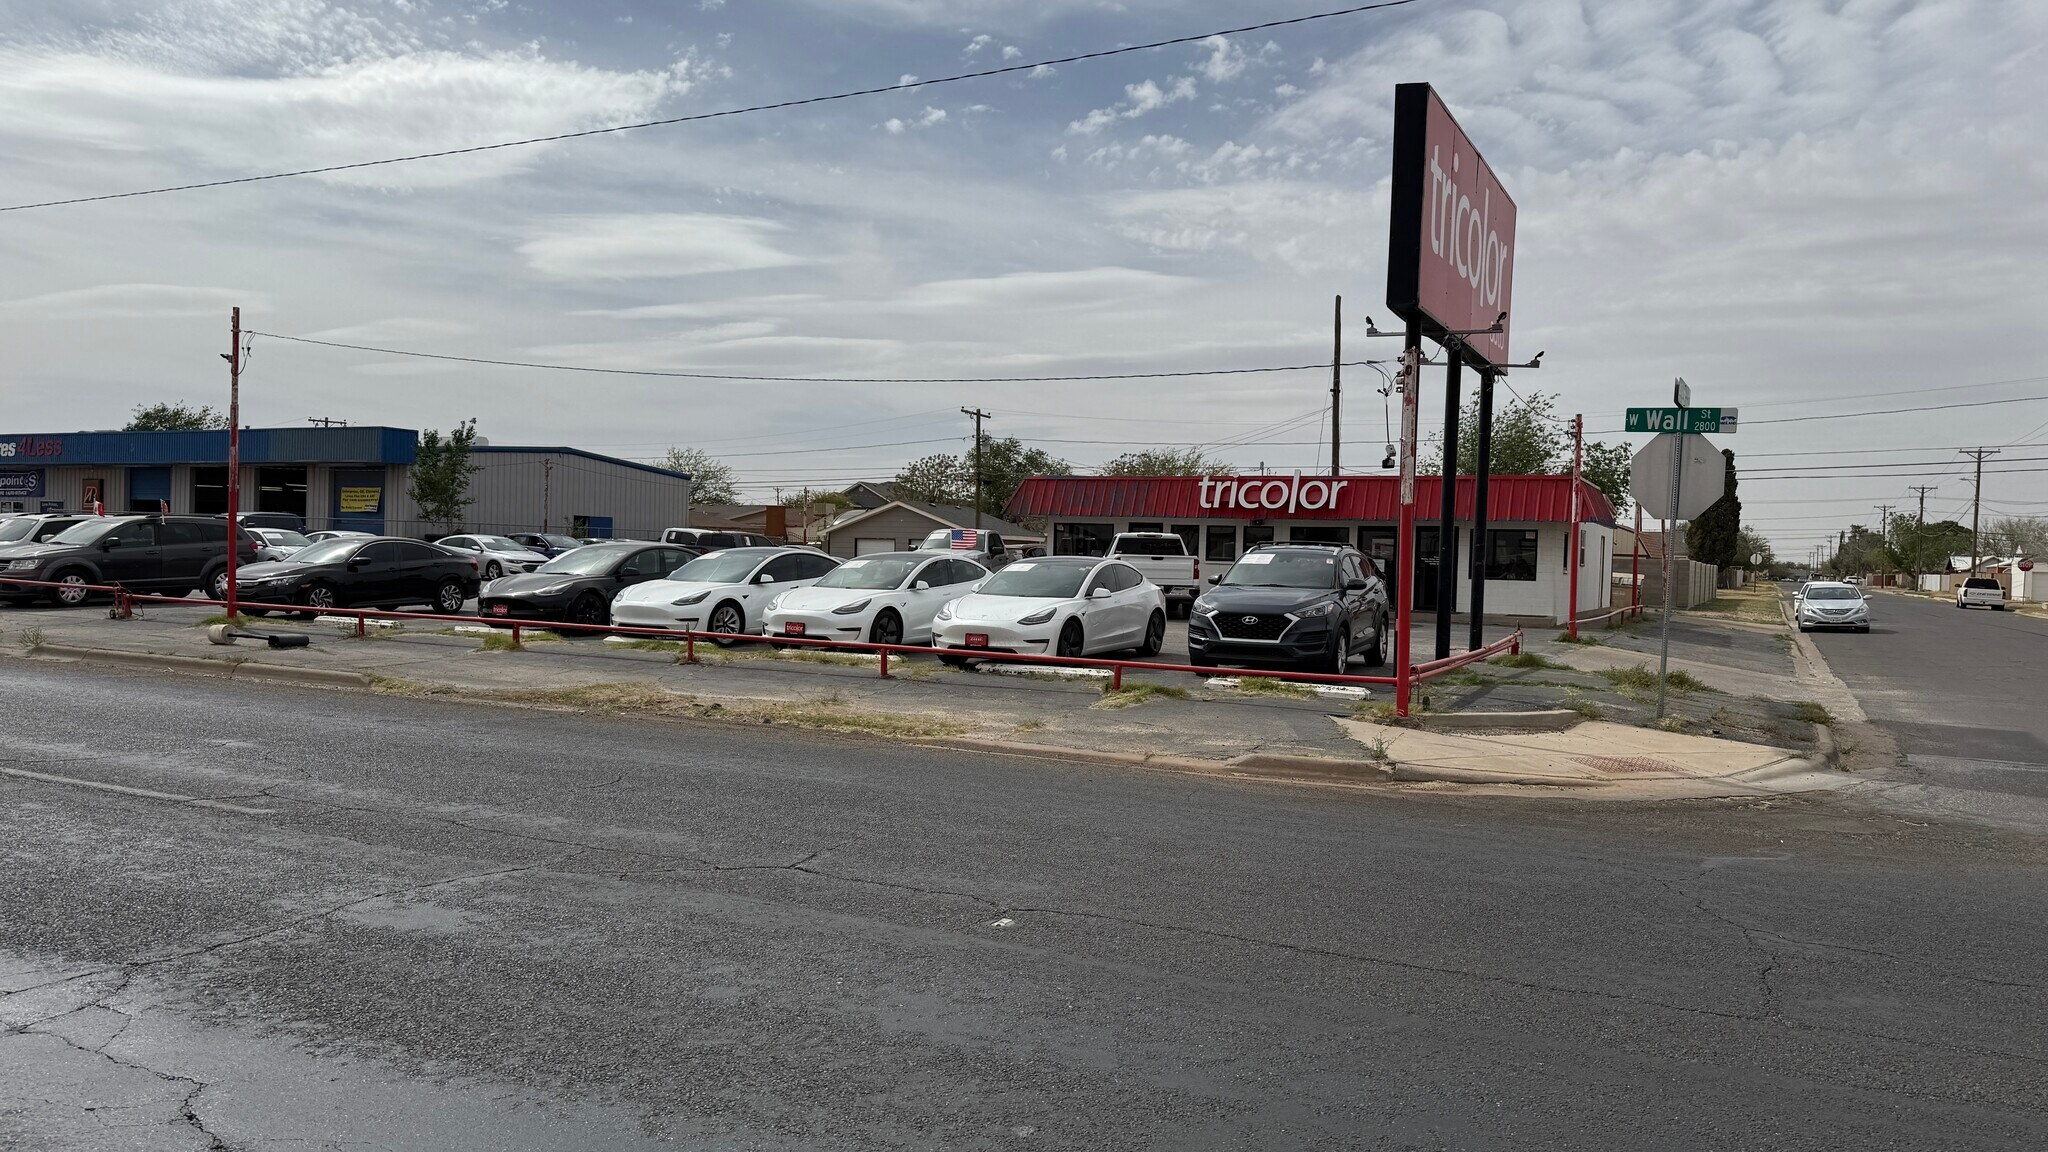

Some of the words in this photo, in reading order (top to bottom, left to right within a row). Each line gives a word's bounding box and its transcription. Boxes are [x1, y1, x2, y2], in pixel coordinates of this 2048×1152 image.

[1430, 144, 1507, 312] tricolor
[1629, 413, 1639, 427] W
[1646, 409, 1689, 431] Wall
[1701, 409, 1712, 419] St
[1694, 421, 1716, 432] 2800
[0, 442, 17, 457] es
[1198, 469, 1348, 514] tricolor
